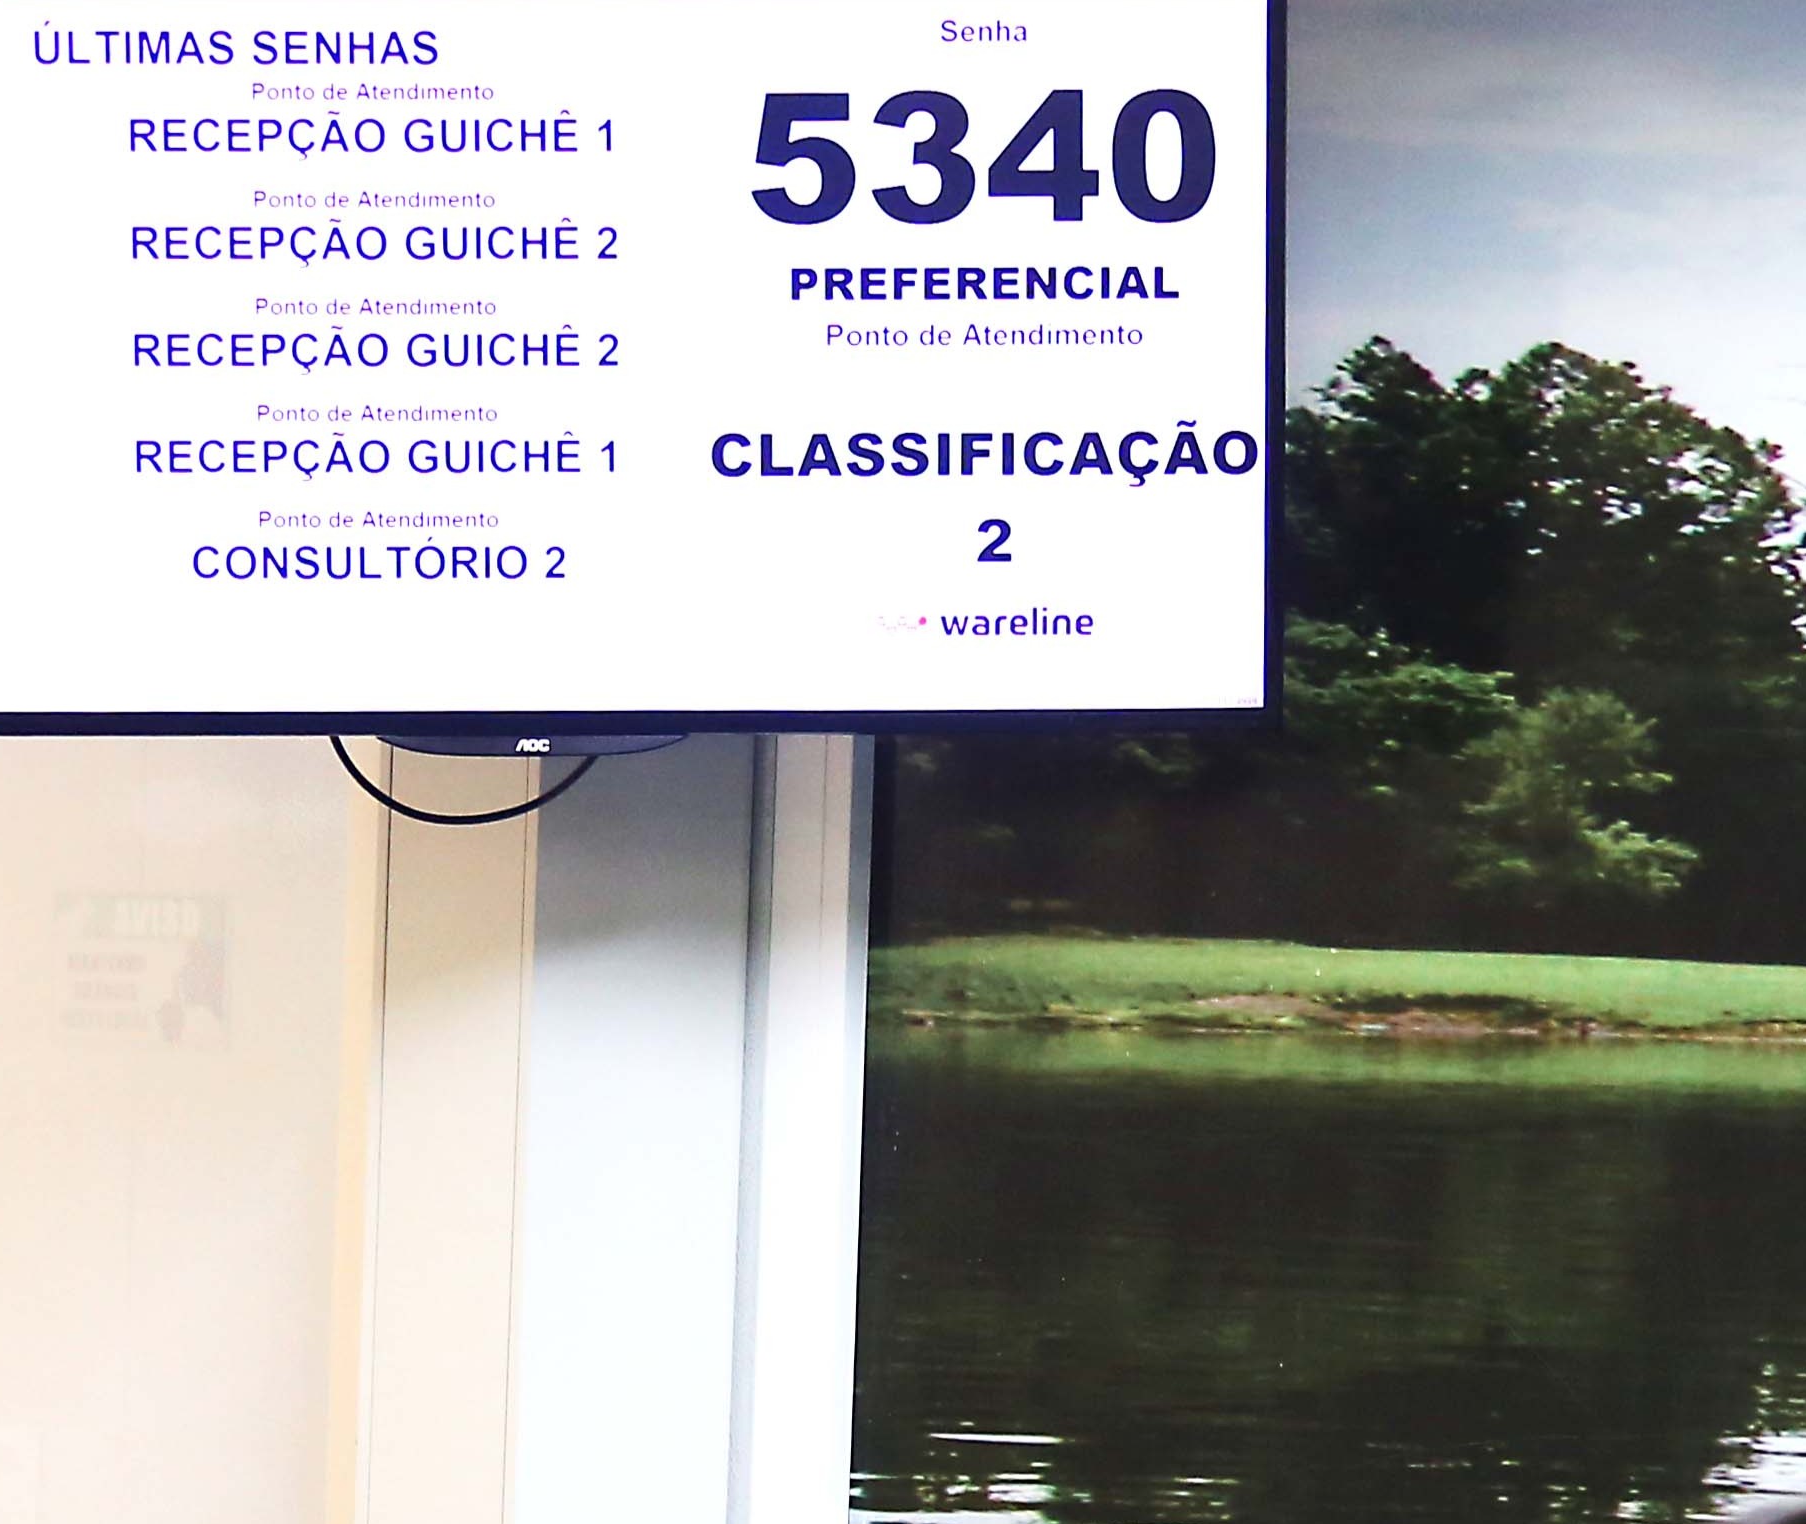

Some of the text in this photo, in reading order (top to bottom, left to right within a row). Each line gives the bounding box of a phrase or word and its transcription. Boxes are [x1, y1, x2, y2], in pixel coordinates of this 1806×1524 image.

[34, 21, 438, 66] ÚLTIMAS SENHAS
[941, 20, 1028, 43] Senha
[252, 82, 494, 101] Ponto de Atendimento
[129, 110, 613, 160] RECEPÇÃO GUICHÊ 1
[751, 88, 1216, 226] 5340
[254, 190, 496, 209] Ponto de Atendimento
[132, 218, 618, 268] RECEPÇÃO GUICHÊ 2
[791, 265, 1180, 301] PREFERENCIAL
[256, 297, 497, 316] Ponto de Atendimento
[134, 325, 619, 374] RECEPÇÃO GUICHÊ 2
[826, 323, 1144, 347] Ponto de Atendimento
[257, 404, 498, 422] Ponto de Atendimento
[136, 431, 615, 481] RECEPÇÃO GUICHÊ 1
[711, 420, 1259, 488] CLASSIFICAÇÃO
[259, 511, 499, 529] Ponto de Atendimento
[193, 537, 566, 580] CONSULTÓRIO 2
[976, 518, 1012, 563] 2
[940, 606, 1094, 636] wareline
